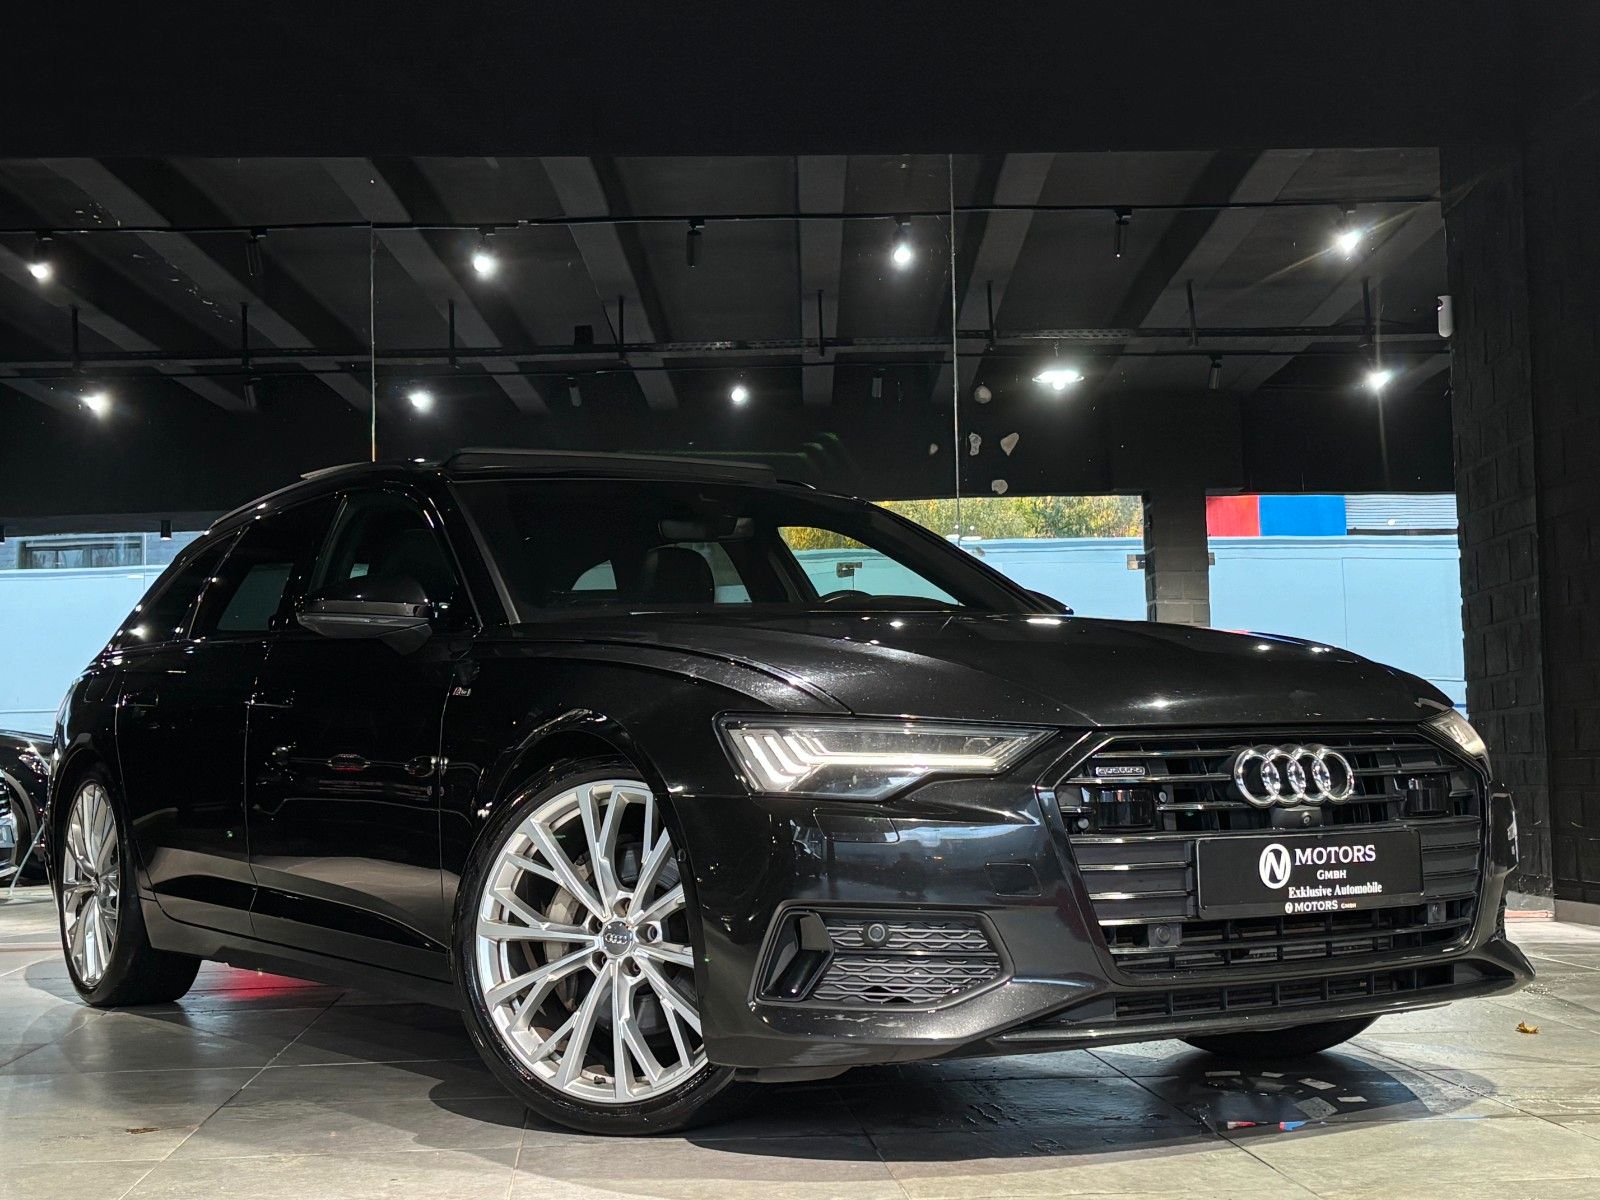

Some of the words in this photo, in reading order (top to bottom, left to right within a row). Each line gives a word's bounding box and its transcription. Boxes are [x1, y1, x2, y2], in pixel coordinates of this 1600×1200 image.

[1294, 844, 1377, 866] MOTORS
[1316, 869, 1347, 880] GMBH
[1288, 885, 1333, 899] Exklusive
[1333, 881, 1383, 897] Automobile
[1294, 900, 1339, 913] MOTORS
